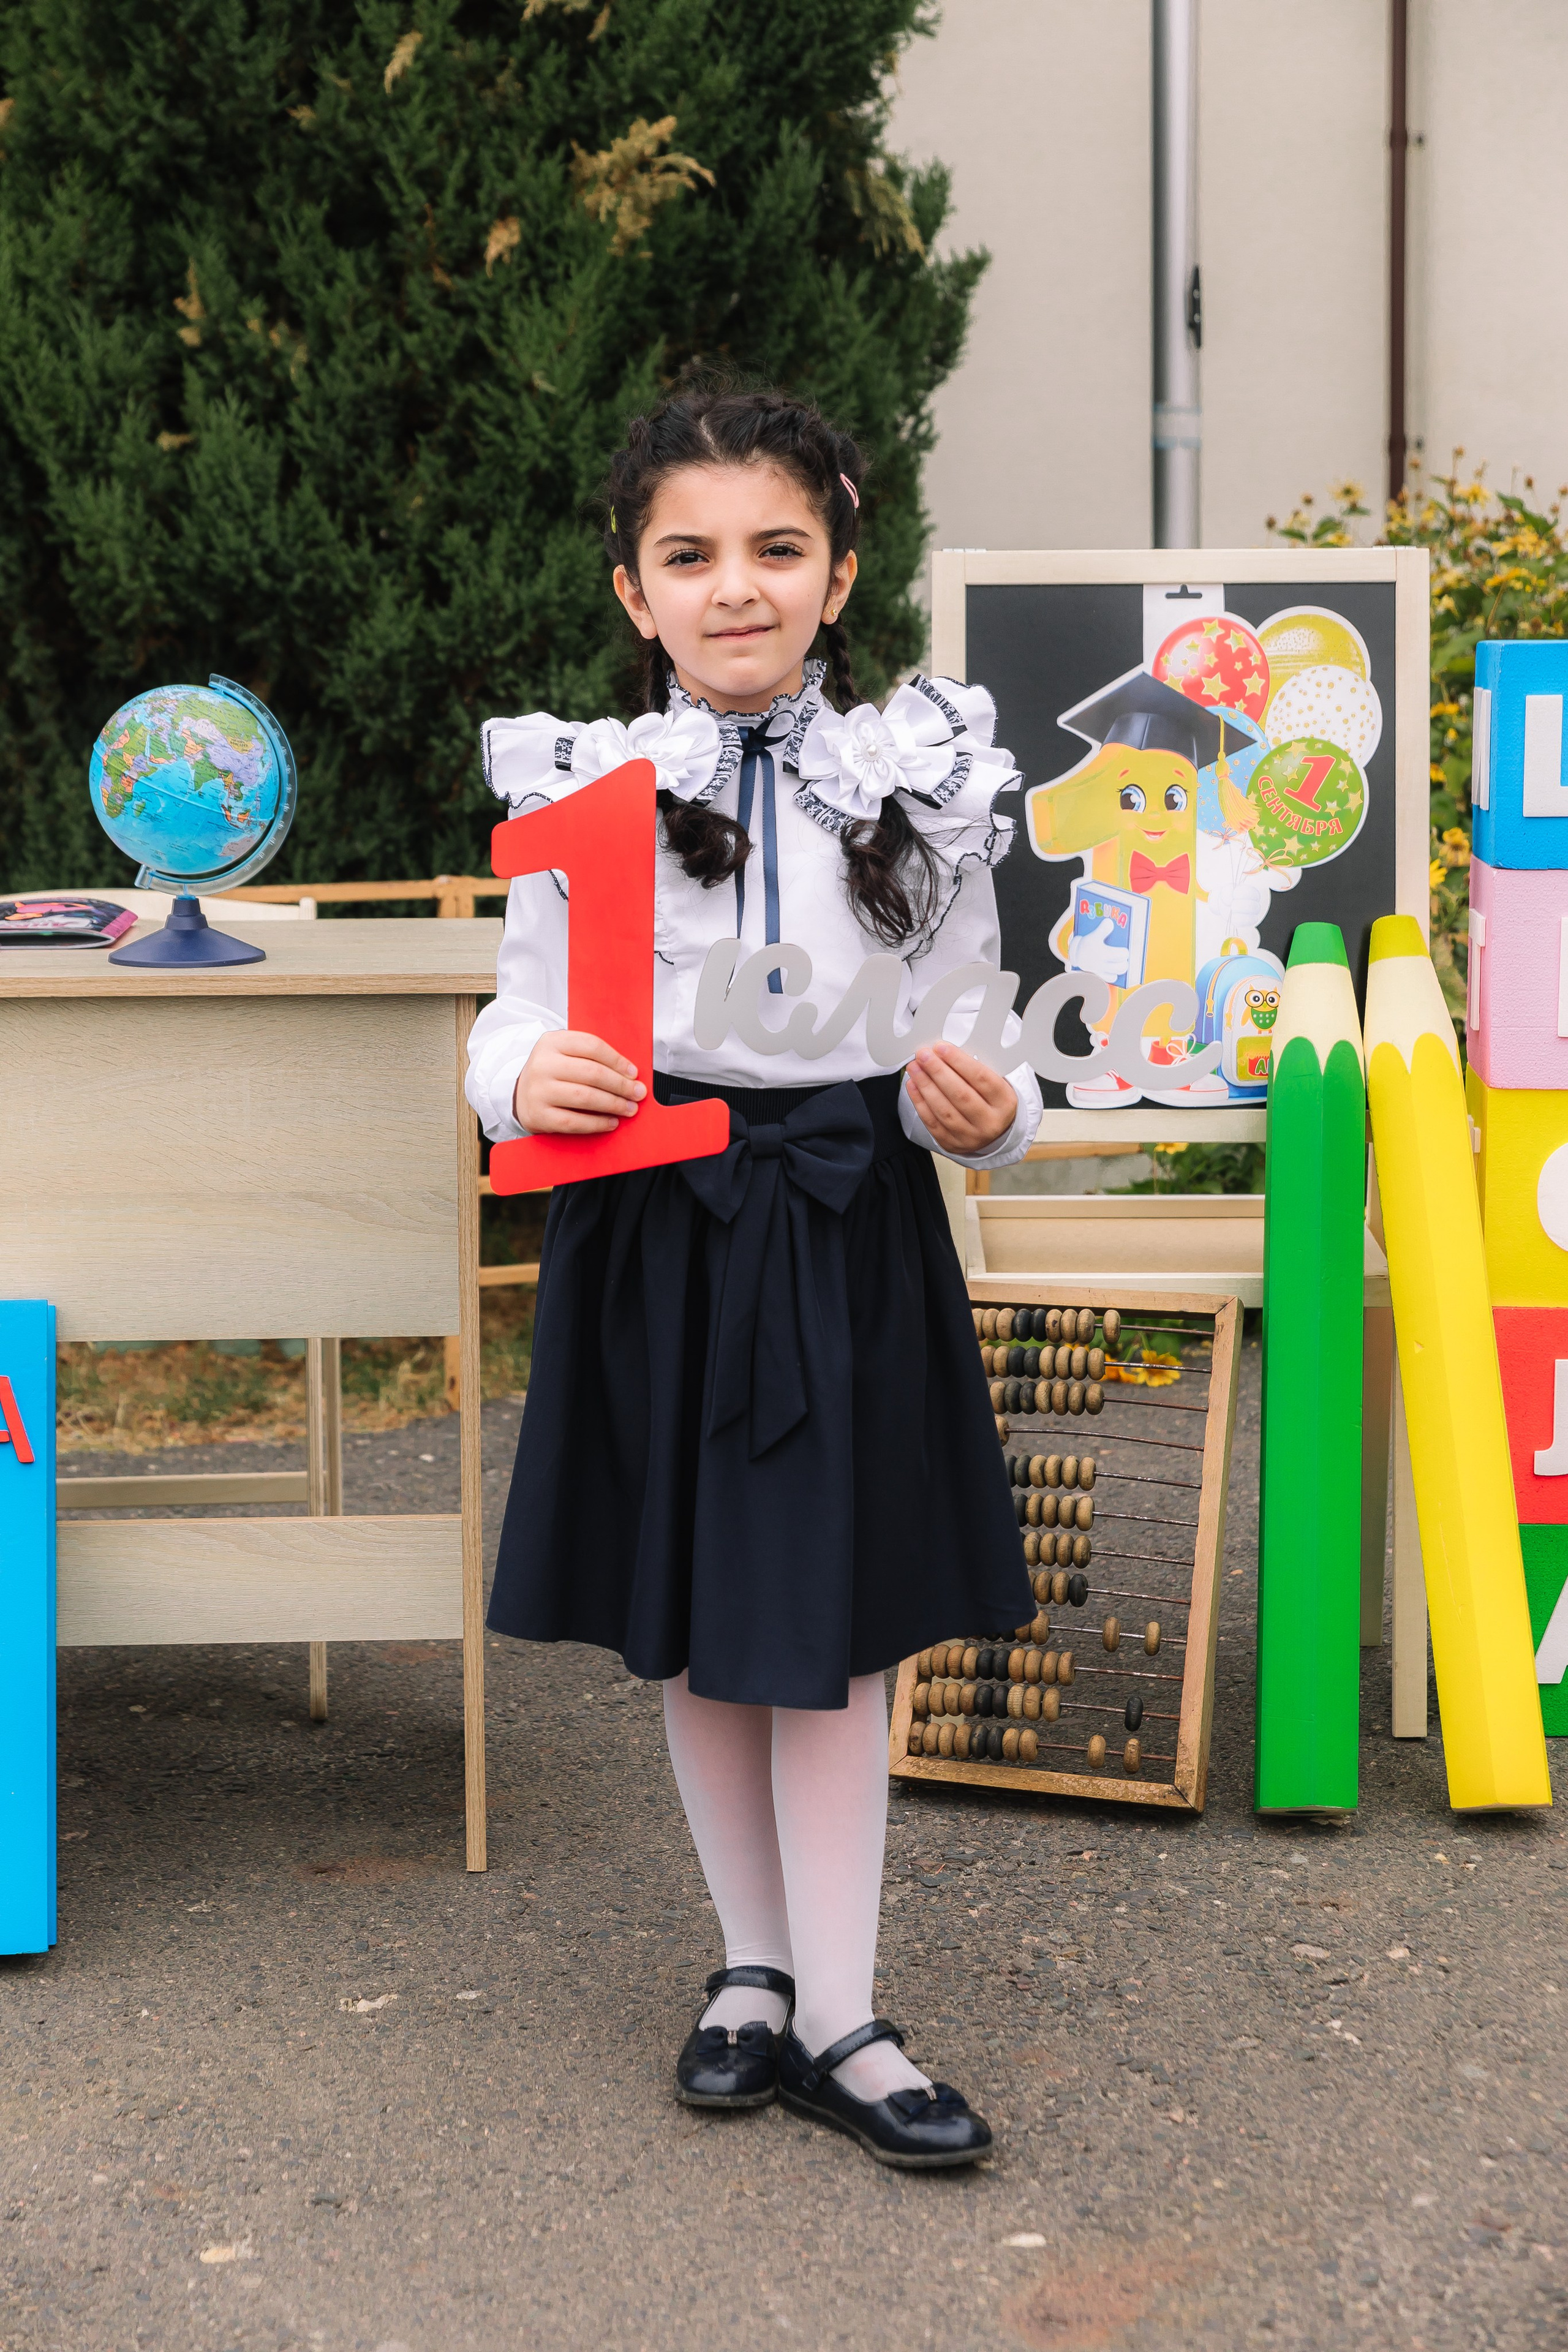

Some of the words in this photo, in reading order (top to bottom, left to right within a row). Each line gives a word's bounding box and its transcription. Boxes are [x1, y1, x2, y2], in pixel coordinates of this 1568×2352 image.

[1257, 775, 1343, 836] СЕНТЯБРЯ
[1283, 755, 1336, 812] 1
[1080, 899, 1127, 929] АЗБУКА
[489, 758, 729, 1196] 1
